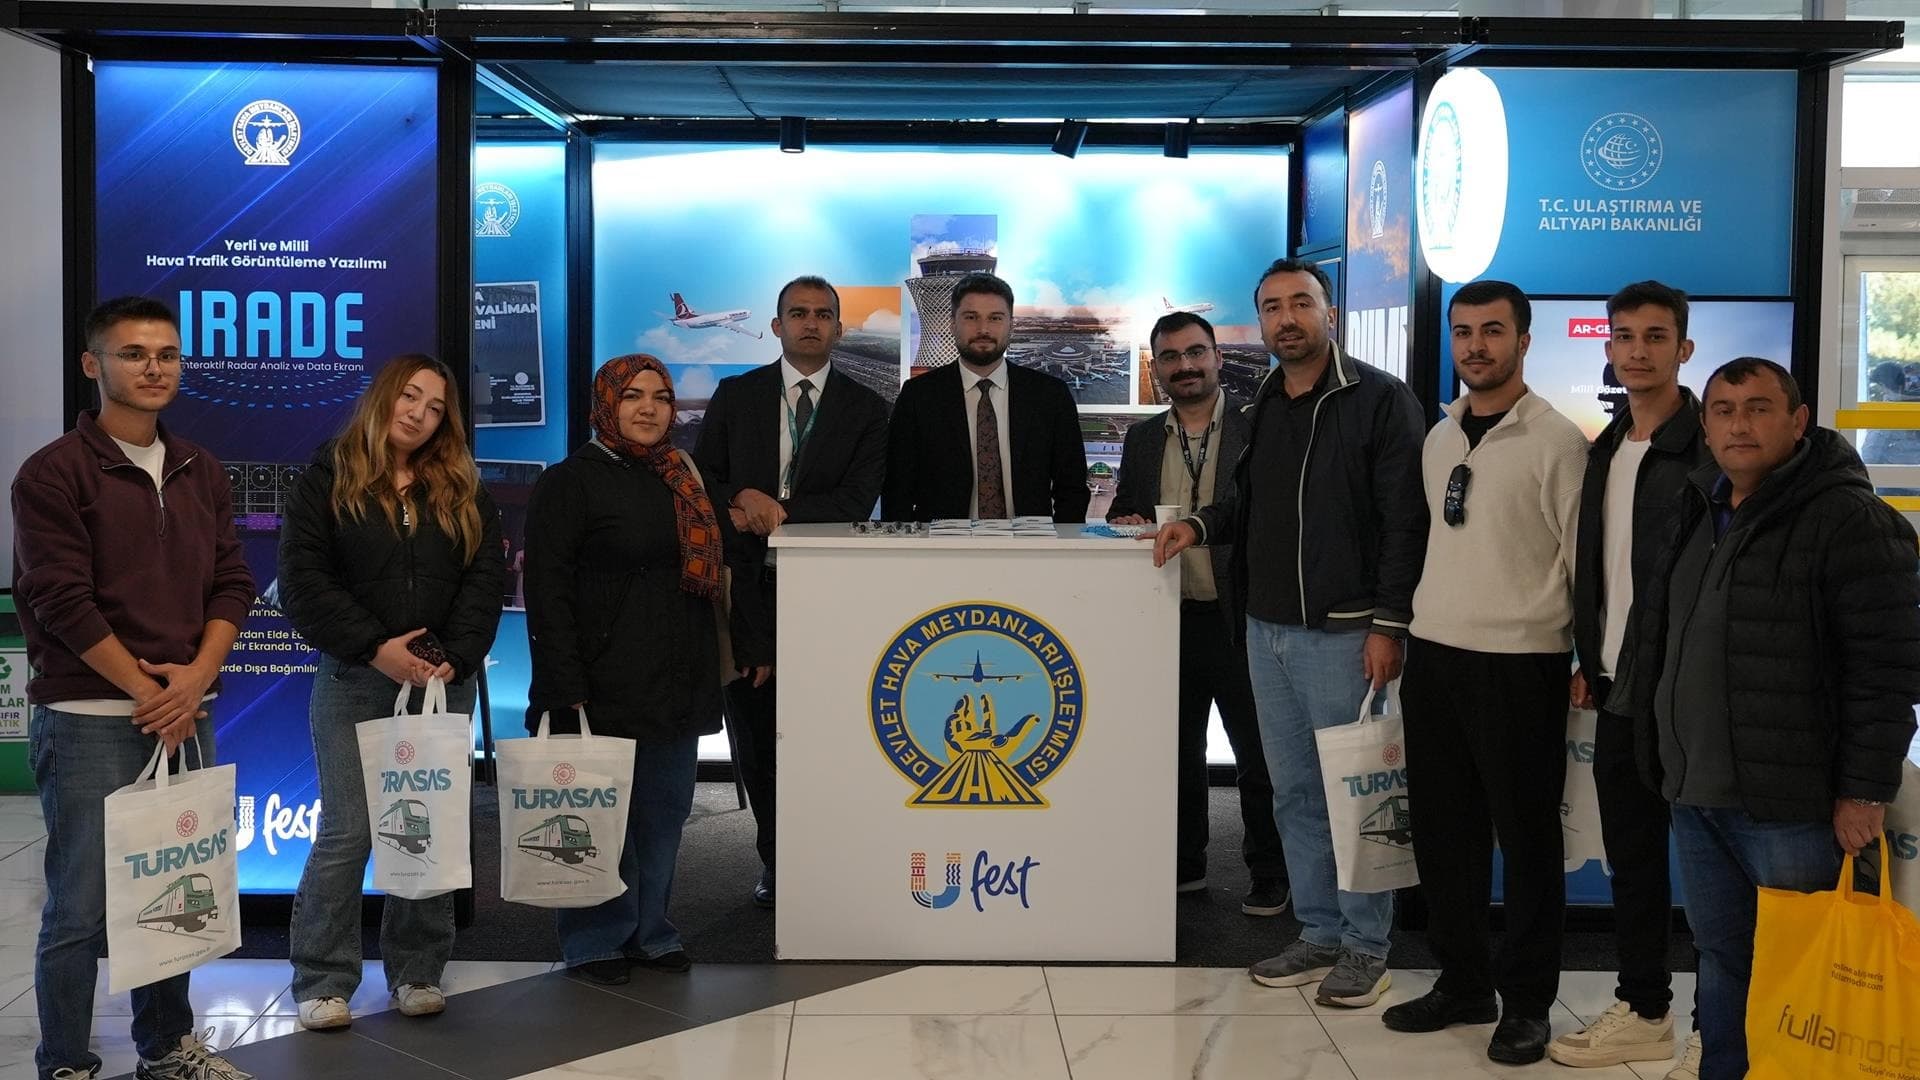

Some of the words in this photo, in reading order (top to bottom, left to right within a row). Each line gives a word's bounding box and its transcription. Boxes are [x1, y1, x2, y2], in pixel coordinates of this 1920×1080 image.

[1539, 199, 1568, 212] T.C.
[1573, 199, 1675, 217] ULAŞTIRMA
[1680, 200, 1702, 213] VE
[1539, 217, 1606, 230] ALTYAPI
[1611, 215, 1701, 231] BAKANLIĞI
[225, 239, 256, 251] Yerli
[260, 242, 277, 251] ve
[280, 240, 309, 252] Milli
[146, 255, 184, 266] Hava
[187, 254, 228, 266] Trafik
[231, 255, 327, 268] Görüntüleme
[329, 257, 387, 269] Yazılımı
[182, 358, 225, 370] nteraktif
[227, 361, 257, 370] Radar
[260, 361, 290, 370] Analiz
[292, 363, 304, 371] ve
[307, 362, 332, 371] Data
[334, 362, 364, 371] Ekranı
[238, 630, 265, 639] rdan
[267, 631, 289, 639] Elde
[920, 609, 1063, 667] MEYDANLARI
[249, 642, 292, 651] Ekranda
[245, 664, 267, 675] Dışa
[882, 637, 922, 692] HAVA
[878, 697, 931, 779] DEVLET
[970, 850, 1040, 912] fest
